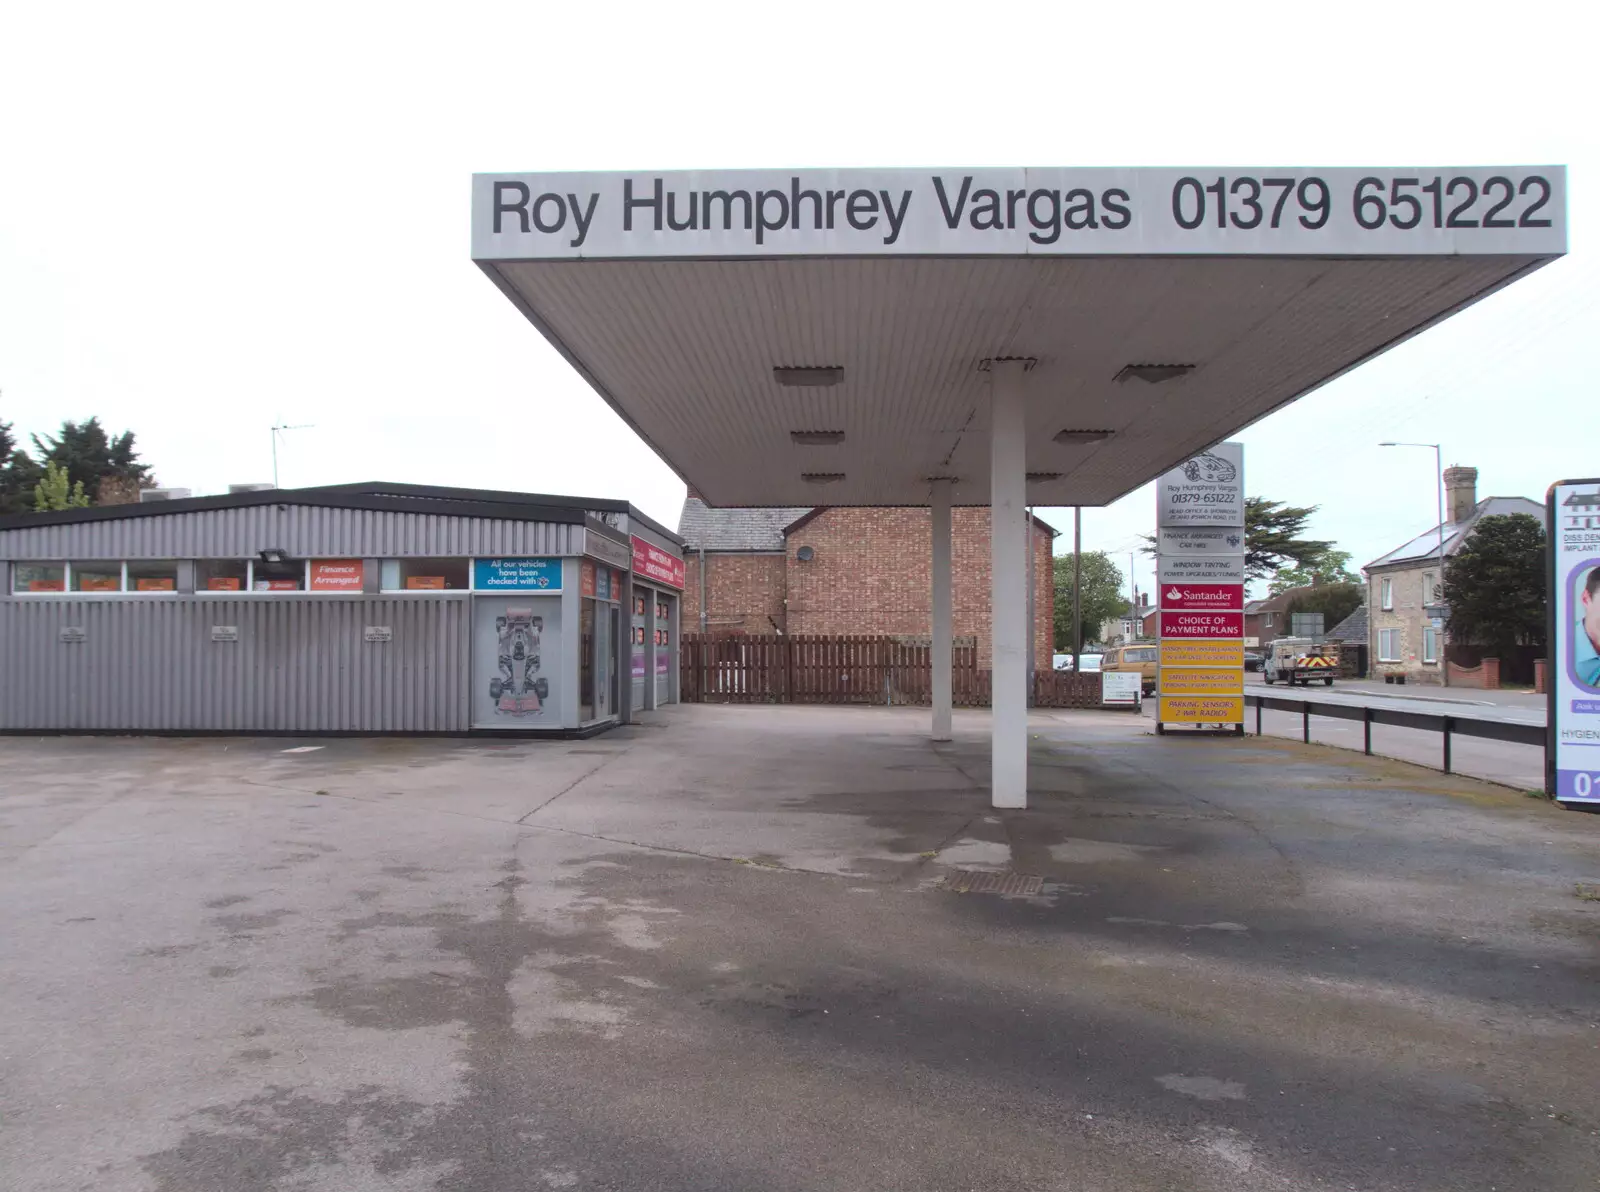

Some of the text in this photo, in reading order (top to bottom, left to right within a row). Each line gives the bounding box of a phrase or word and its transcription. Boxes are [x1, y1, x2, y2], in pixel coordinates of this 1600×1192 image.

[493, 176, 1552, 247] Roy Humphrey Vargas 01379 651222
[1172, 494, 1235, 503] 01379-651222
[499, 568, 538, 576] have been
[314, 576, 360, 586] Arranged
[487, 577, 536, 585] checked with
[1183, 590, 1232, 600] Santander
